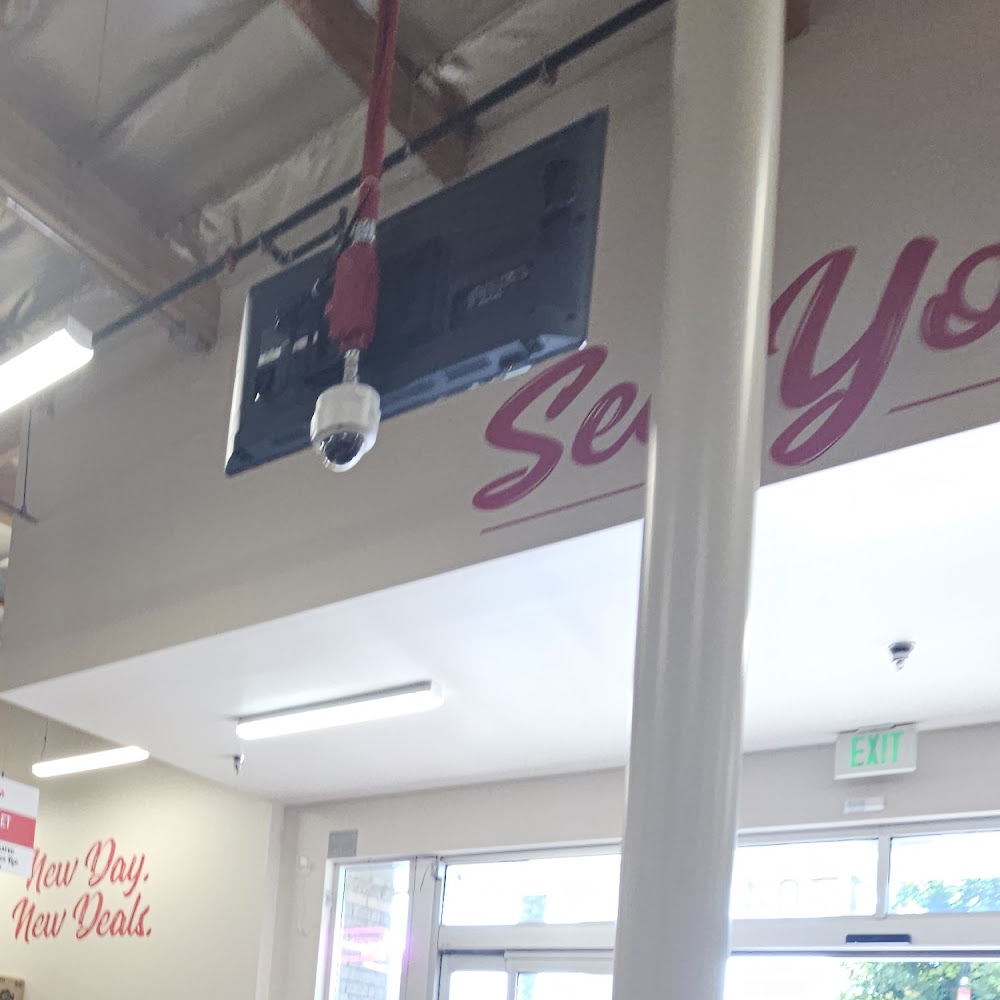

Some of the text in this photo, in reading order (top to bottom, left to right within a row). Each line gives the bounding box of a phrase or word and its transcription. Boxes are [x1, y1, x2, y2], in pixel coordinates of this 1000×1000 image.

[850, 730, 904, 767] EXIT
[84, 838, 149, 897] Day.
[12, 891, 152, 943] New Deals.
